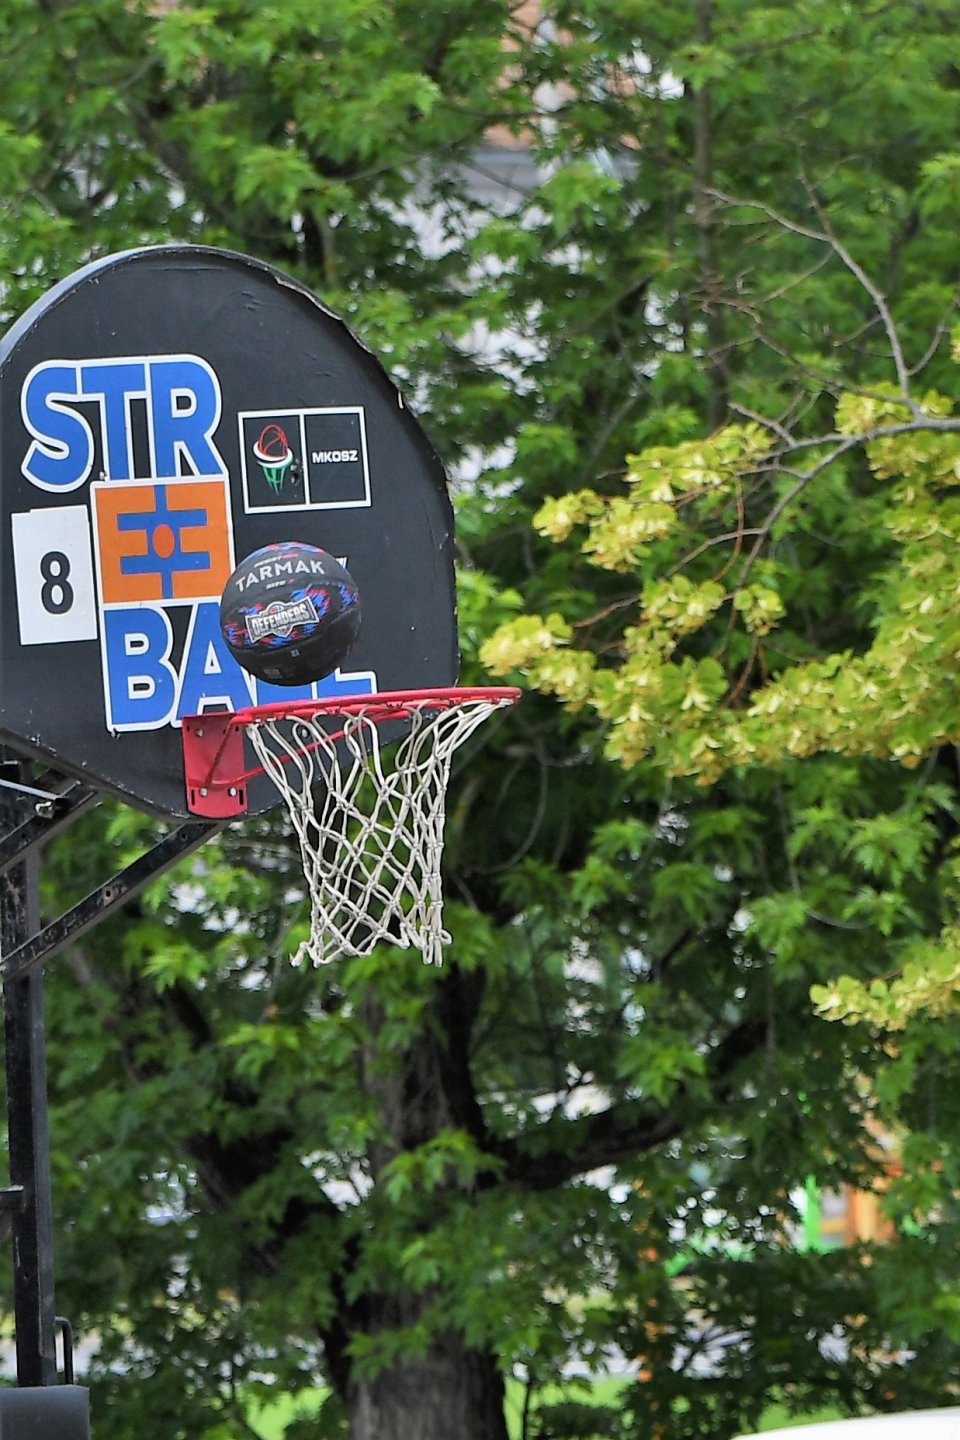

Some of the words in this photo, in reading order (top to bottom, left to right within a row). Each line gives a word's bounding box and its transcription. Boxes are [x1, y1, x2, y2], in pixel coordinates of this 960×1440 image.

[312, 450, 358, 463] MKOSZ
[39, 551, 75, 614] 8
[235, 560, 325, 592] TARMAK
[250, 603, 310, 635] DEFENDERS
